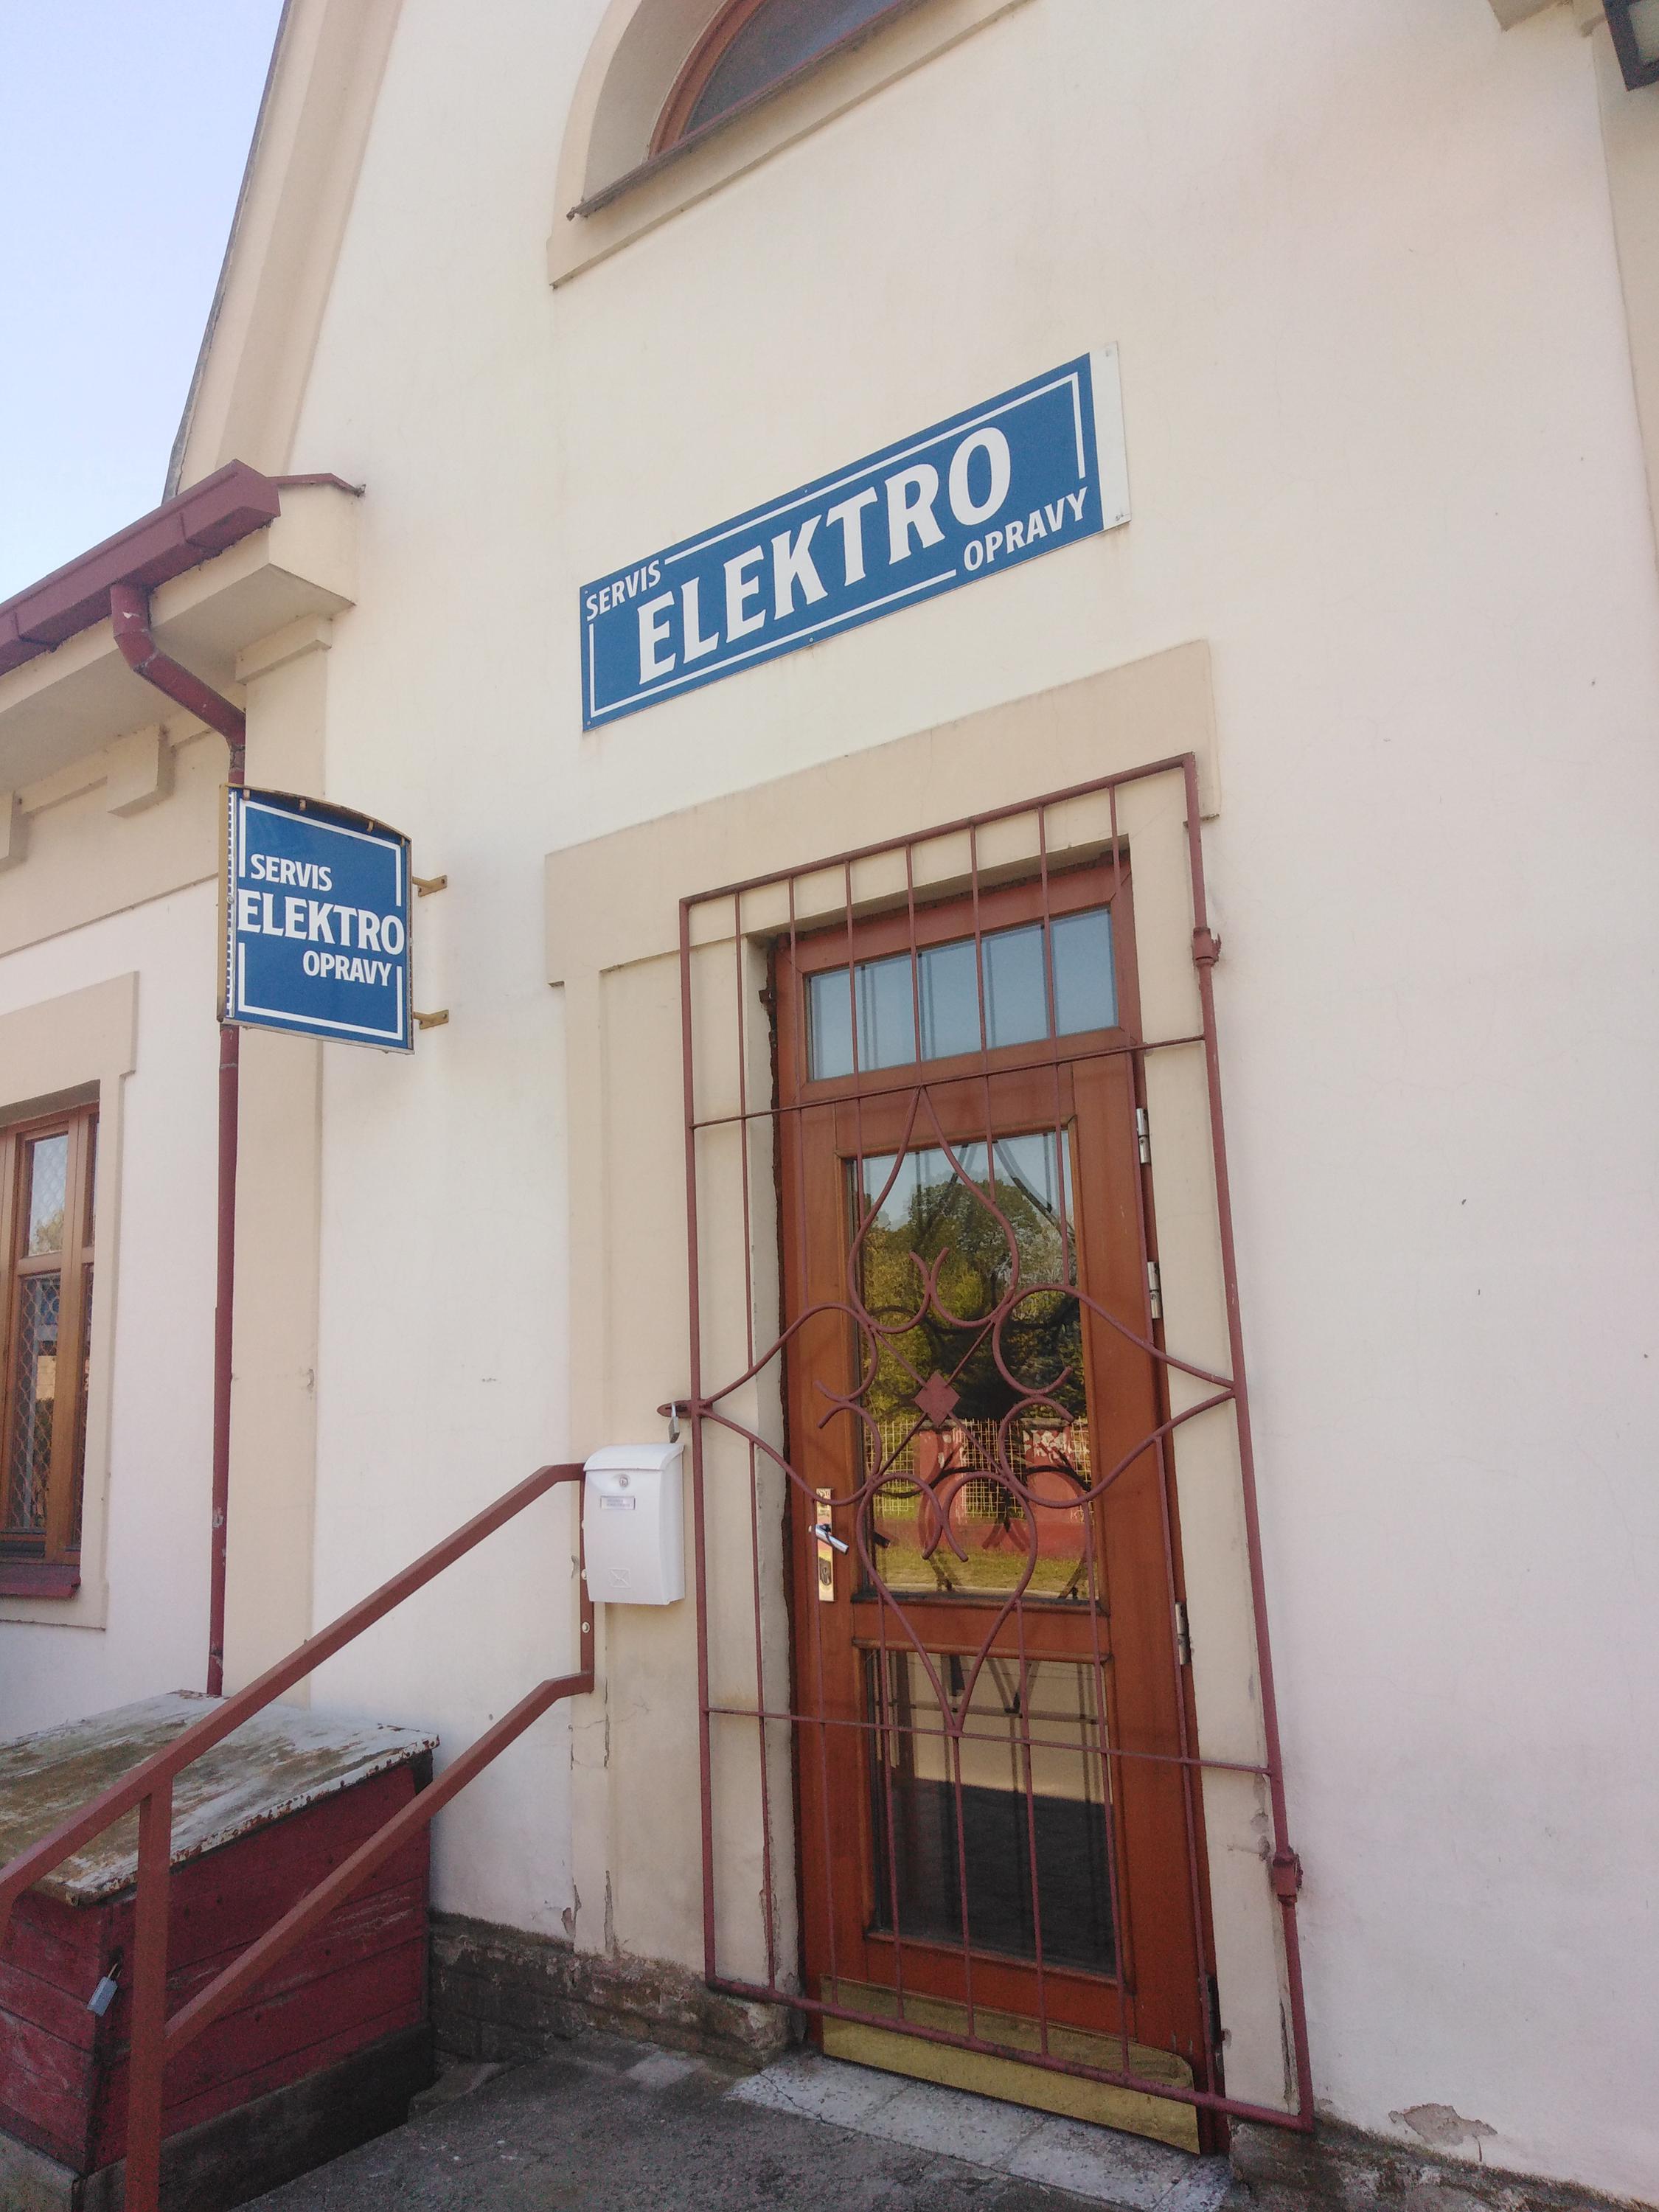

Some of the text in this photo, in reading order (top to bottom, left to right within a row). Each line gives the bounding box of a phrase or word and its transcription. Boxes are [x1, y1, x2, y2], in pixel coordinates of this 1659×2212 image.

[637, 427, 1011, 684] ELEKTRO
[964, 487, 1088, 571] OPRAVY
[586, 560, 661, 621] SERVIS
[251, 854, 333, 891] SERVIS
[237, 888, 405, 956] ELEKTRO
[303, 950, 392, 987] OPRAVY
